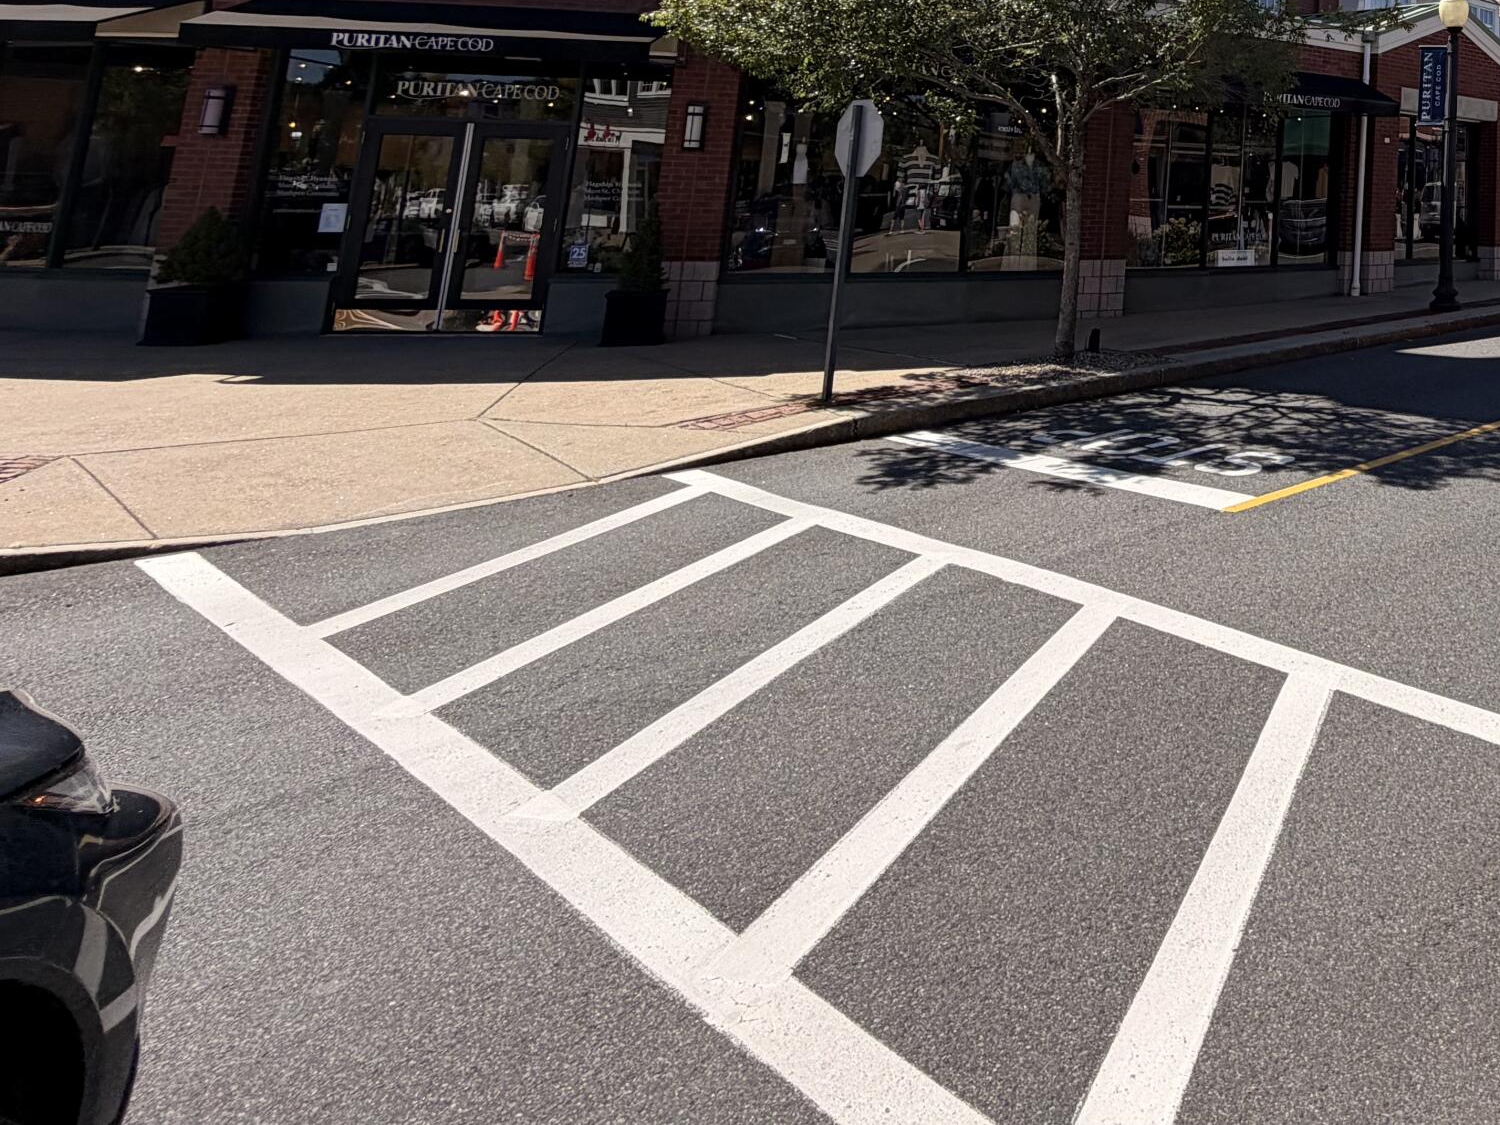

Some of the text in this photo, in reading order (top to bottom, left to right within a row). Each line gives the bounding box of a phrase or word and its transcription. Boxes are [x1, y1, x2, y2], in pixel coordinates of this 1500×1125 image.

[330, 32, 495, 52] PURITAN CAPE COD
[396, 80, 561, 101] PURITAN CAPE COD
[1421, 52, 1433, 120] PURITAN
[1434, 86, 1442, 107] CAPE
